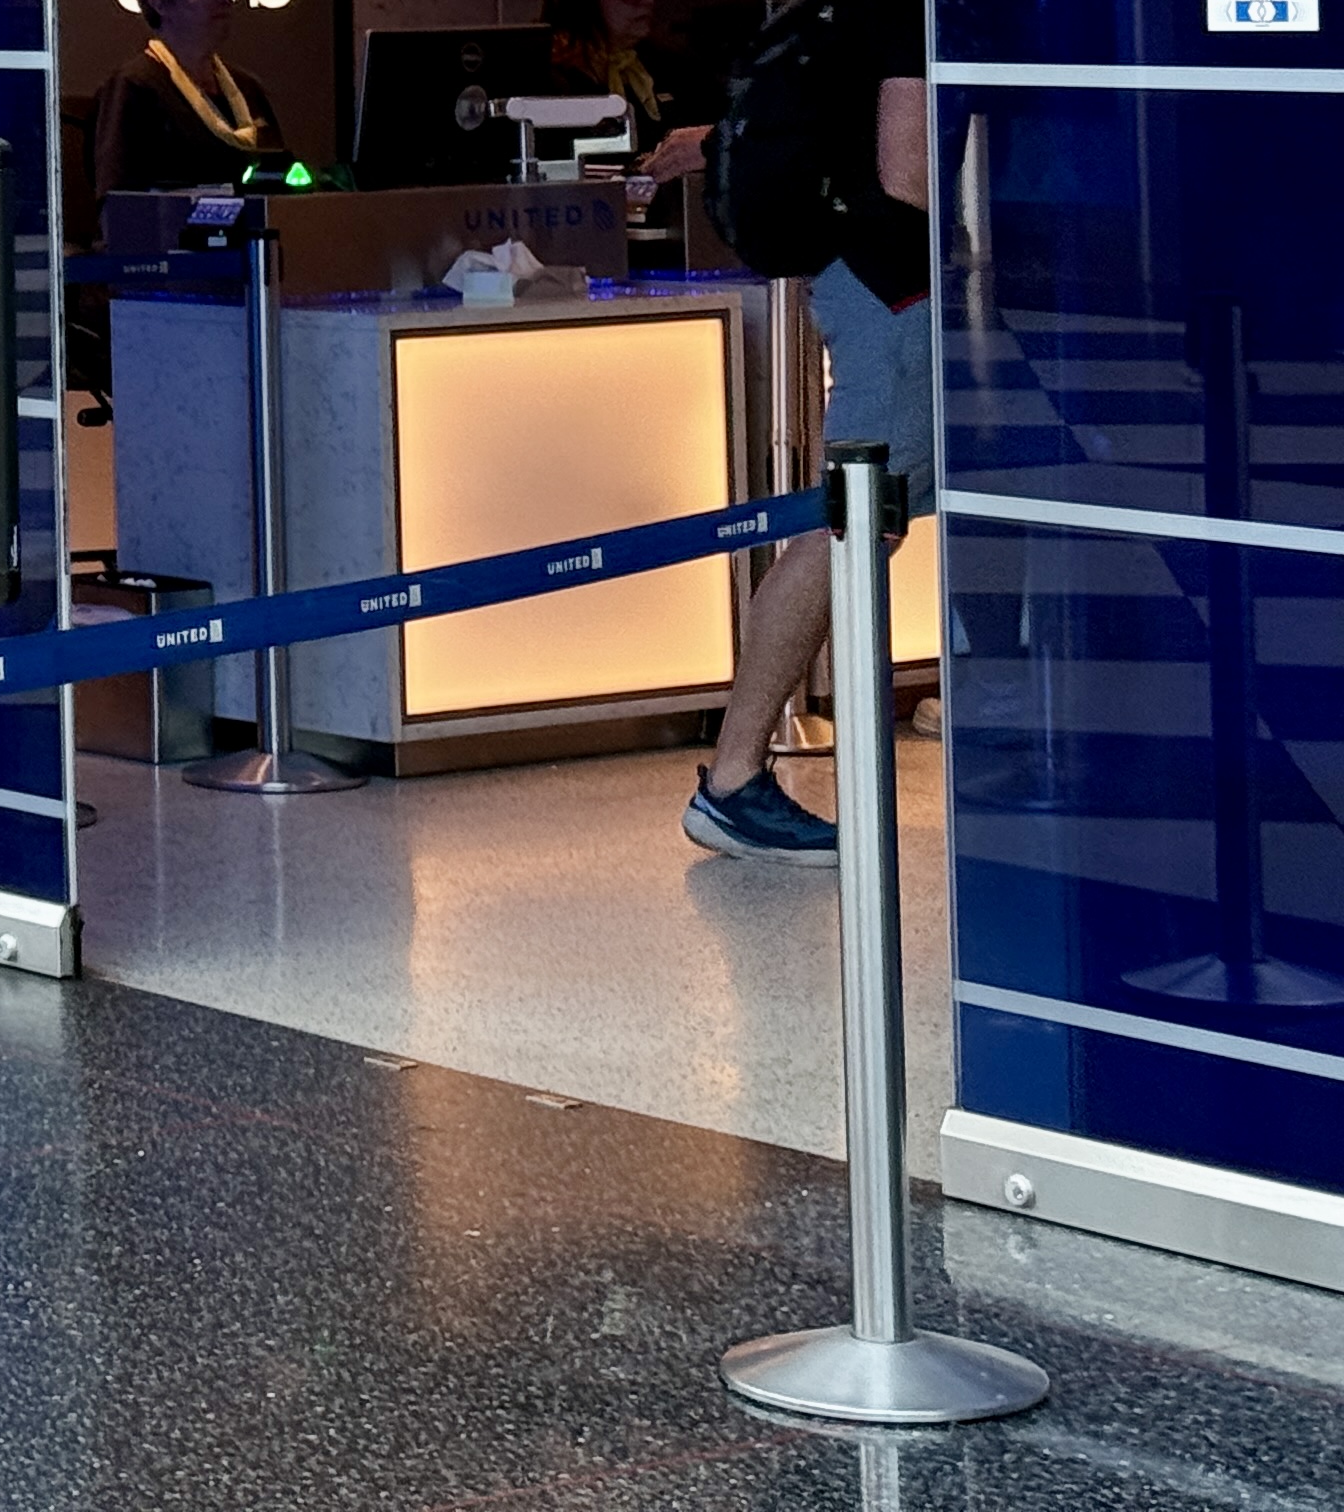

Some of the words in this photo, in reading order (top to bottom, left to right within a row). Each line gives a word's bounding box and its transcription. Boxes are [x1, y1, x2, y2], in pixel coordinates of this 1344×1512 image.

[464, 205, 581, 231] UNITED
[547, 555, 590, 575] UNITED
[361, 591, 408, 613] UNITED
[156, 626, 207, 648] UNITED
